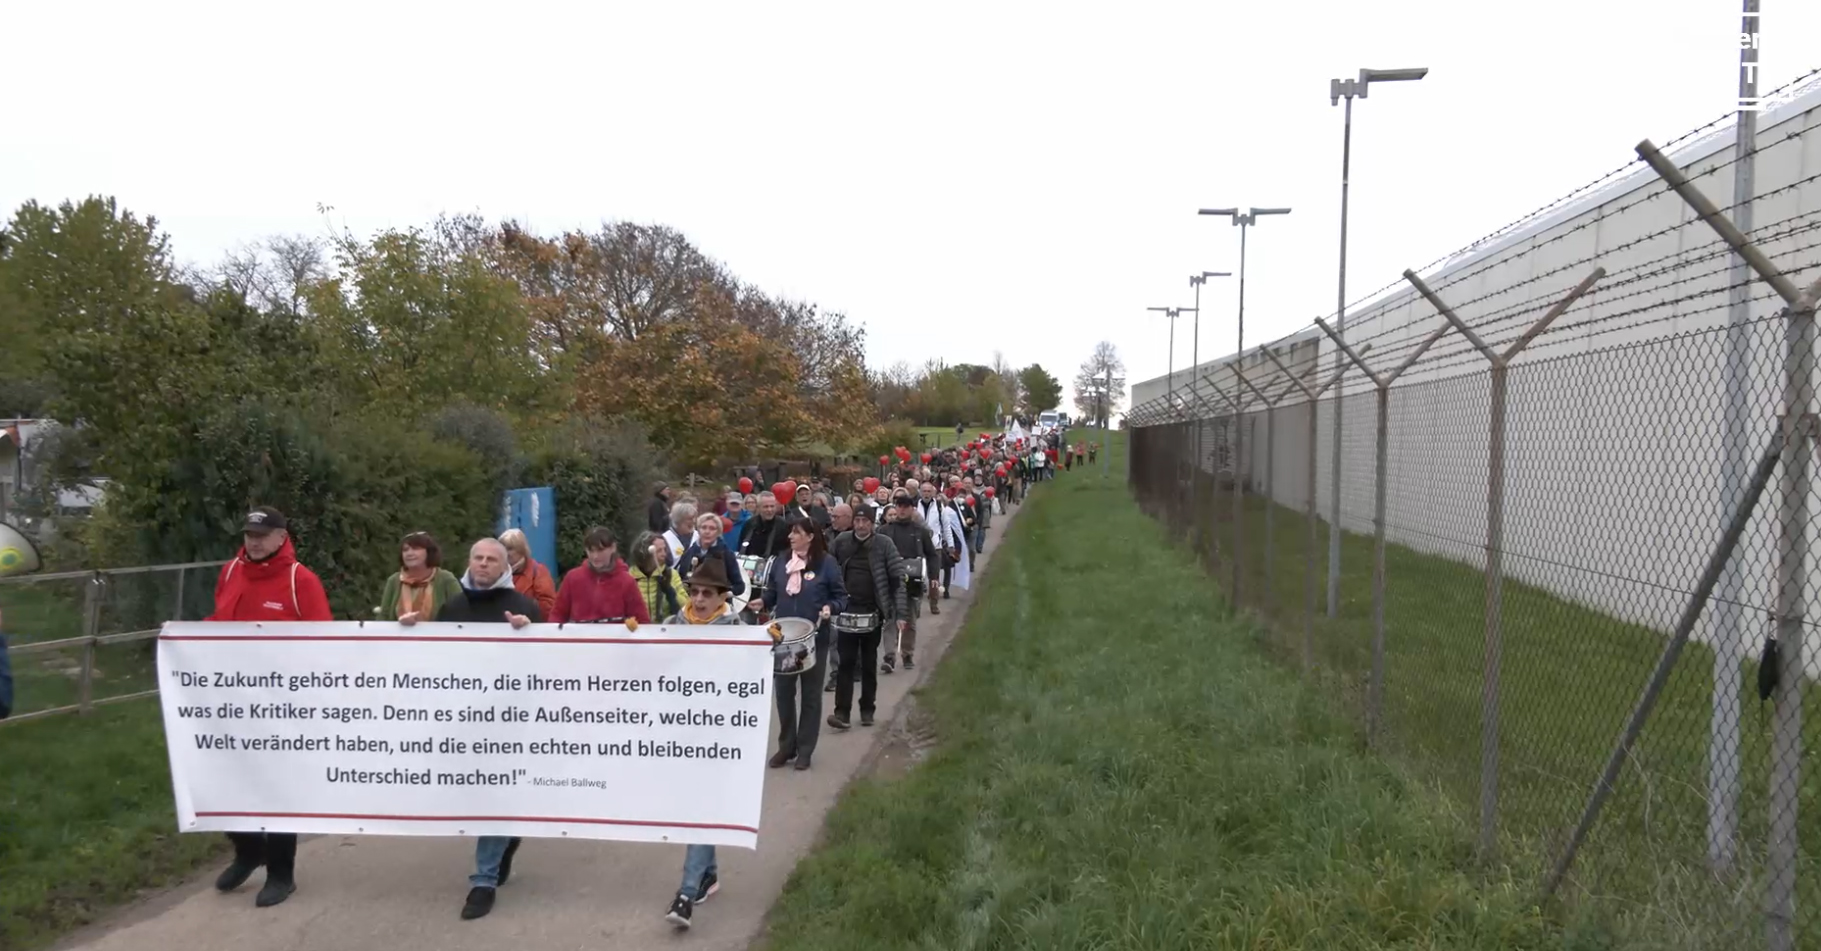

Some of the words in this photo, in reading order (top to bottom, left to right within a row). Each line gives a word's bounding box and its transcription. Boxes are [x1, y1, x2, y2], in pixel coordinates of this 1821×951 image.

[171, 670, 209, 688] "Die
[213, 670, 285, 689] Zukunft
[288, 671, 350, 693] gehört
[353, 671, 387, 689] den
[392, 672, 489, 694] Menschen,
[493, 673, 522, 692] die
[526, 673, 582, 692] ihrem
[587, 674, 653, 693] Herzen
[656, 674, 722, 698] folgen,
[726, 677, 765, 700] egal
[177, 705, 213, 719] was
[216, 702, 245, 720] die
[249, 702, 318, 720] Kritiker
[321, 706, 378, 724] sagen.
[382, 704, 429, 722] Denn
[433, 708, 454, 723] es
[457, 705, 496, 723] sind
[500, 705, 530, 723] die
[534, 705, 654, 728] Außenseiter,
[658, 708, 726, 727] welche
[730, 709, 759, 728] die
[194, 733, 237, 751] Welt
[240, 733, 331, 752] verändert
[335, 734, 395, 756] haben,
[399, 736, 434, 754] und
[438, 736, 468, 755] die
[471, 737, 524, 755] einen
[528, 737, 592, 756] echten
[597, 738, 633, 757] und
[637, 739, 742, 761] bleibenden
[326, 766, 432, 786] Unterschied
[436, 768, 527, 786] machen!"
[532, 776, 570, 787] Michael
[570, 777, 608, 791] Ballweg
